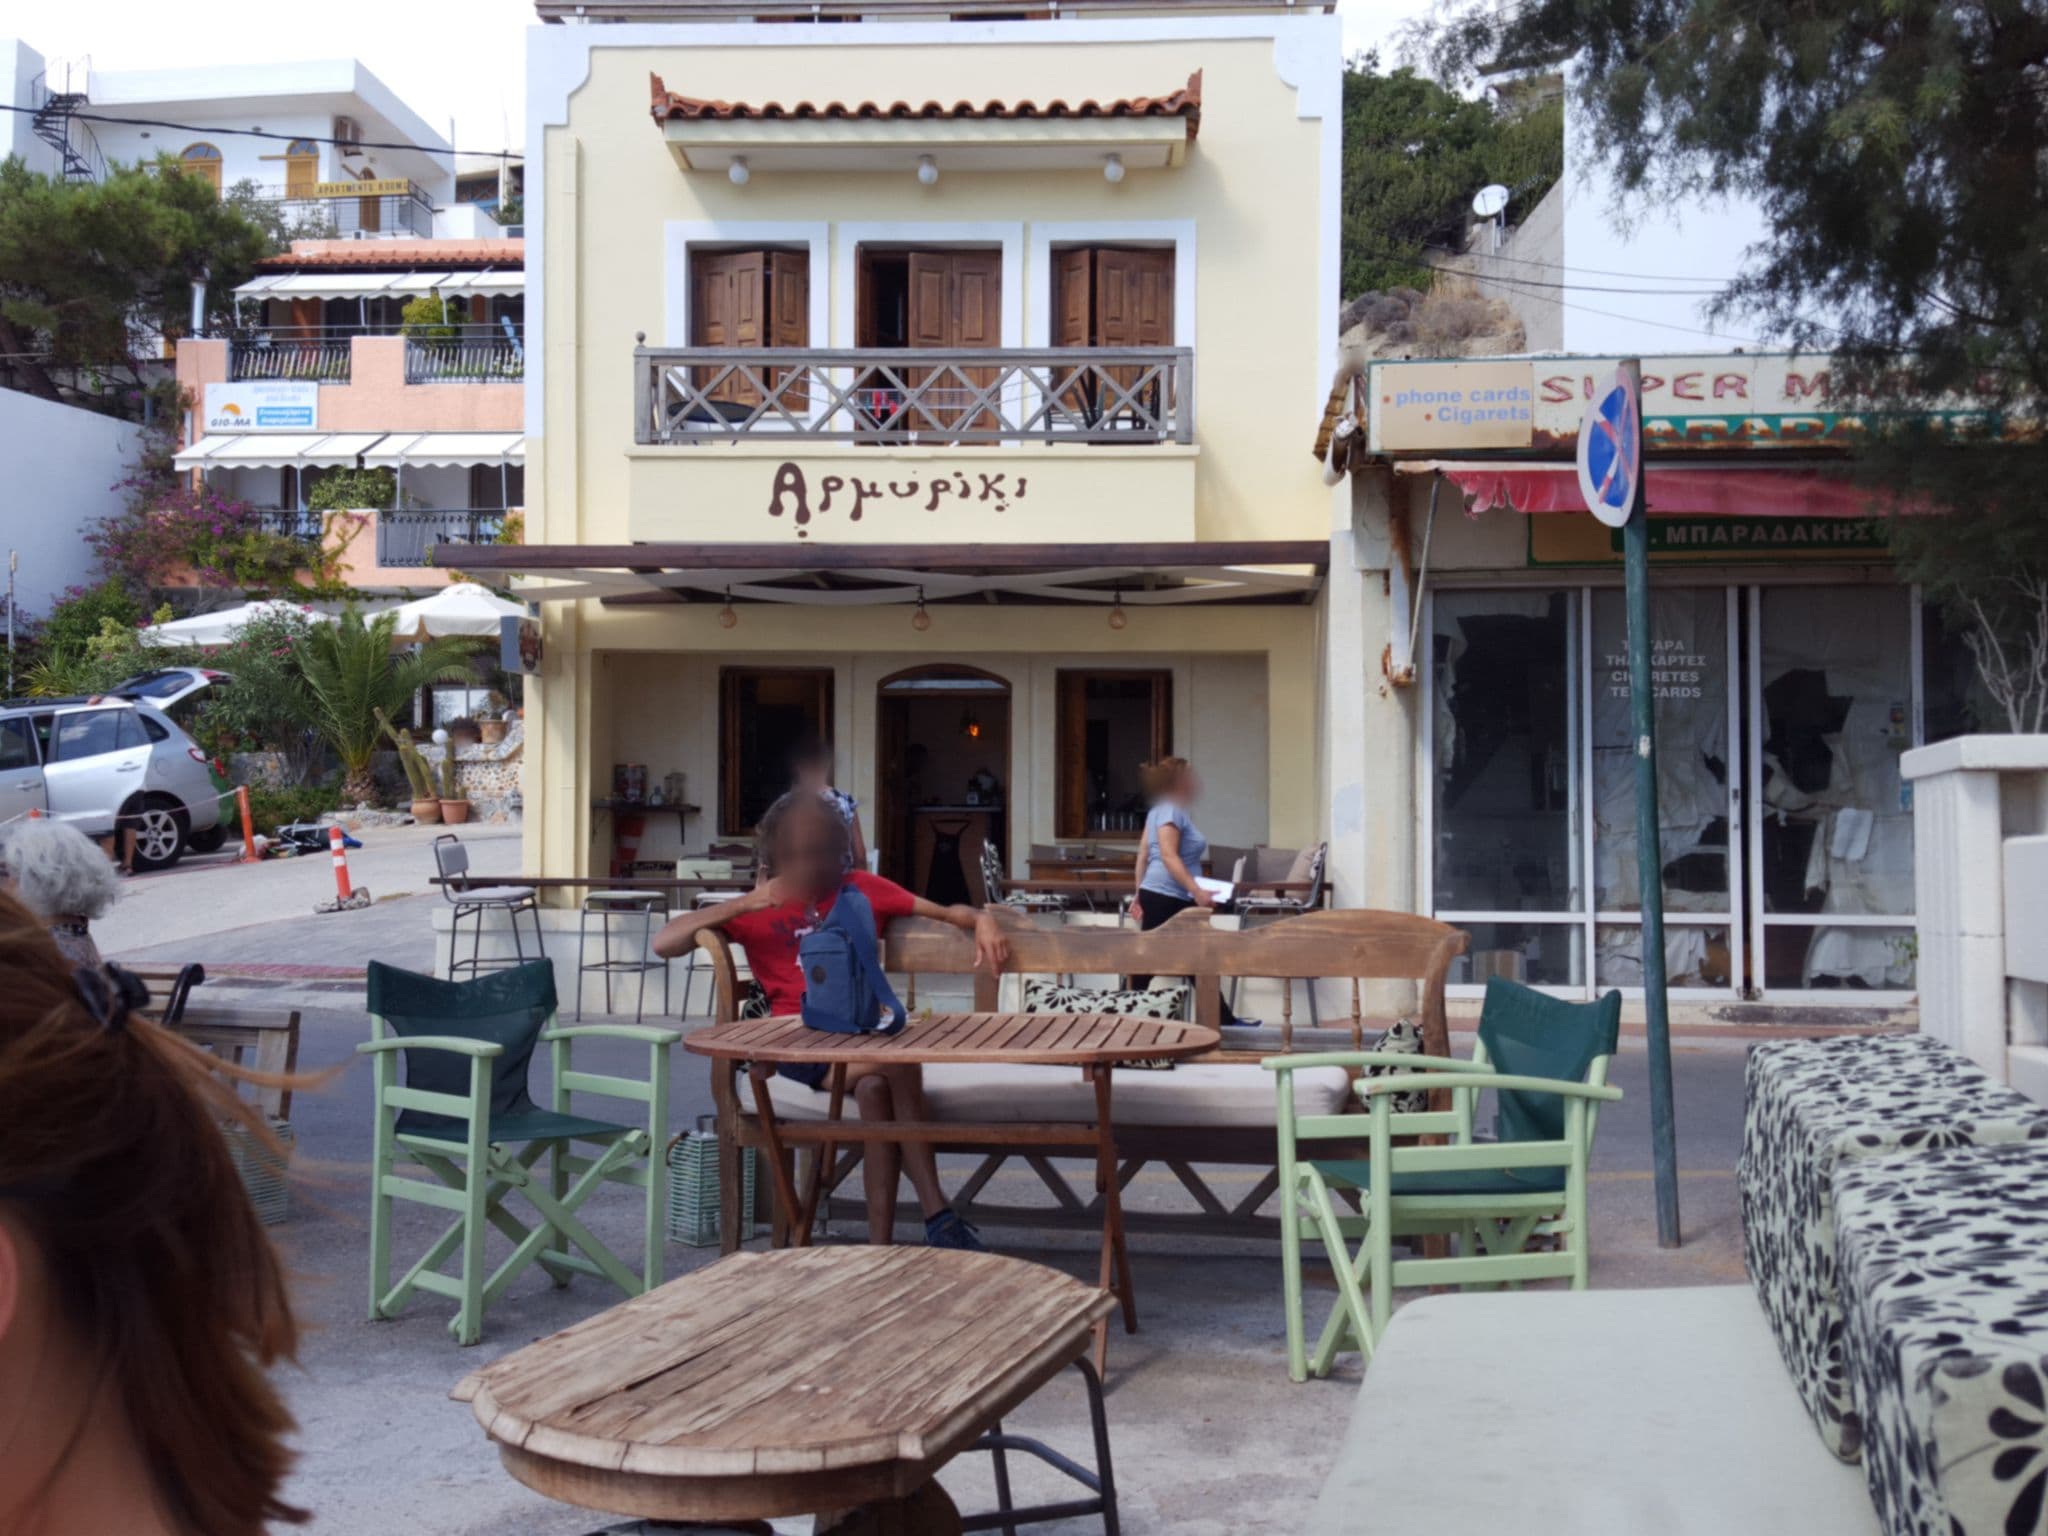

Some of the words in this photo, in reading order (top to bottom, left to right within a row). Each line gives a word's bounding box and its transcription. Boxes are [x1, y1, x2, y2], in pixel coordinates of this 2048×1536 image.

[1395, 388, 1463, 407] phone
[1470, 387, 1531, 402] cards
[211, 418, 251, 427] GIO-MA
[1437, 406, 1531, 424] Cigarets
[1665, 523, 1871, 545] ΜΠΑΡΑΔΑΚΗΣ
[1611, 671, 1699, 682] CIRETES
